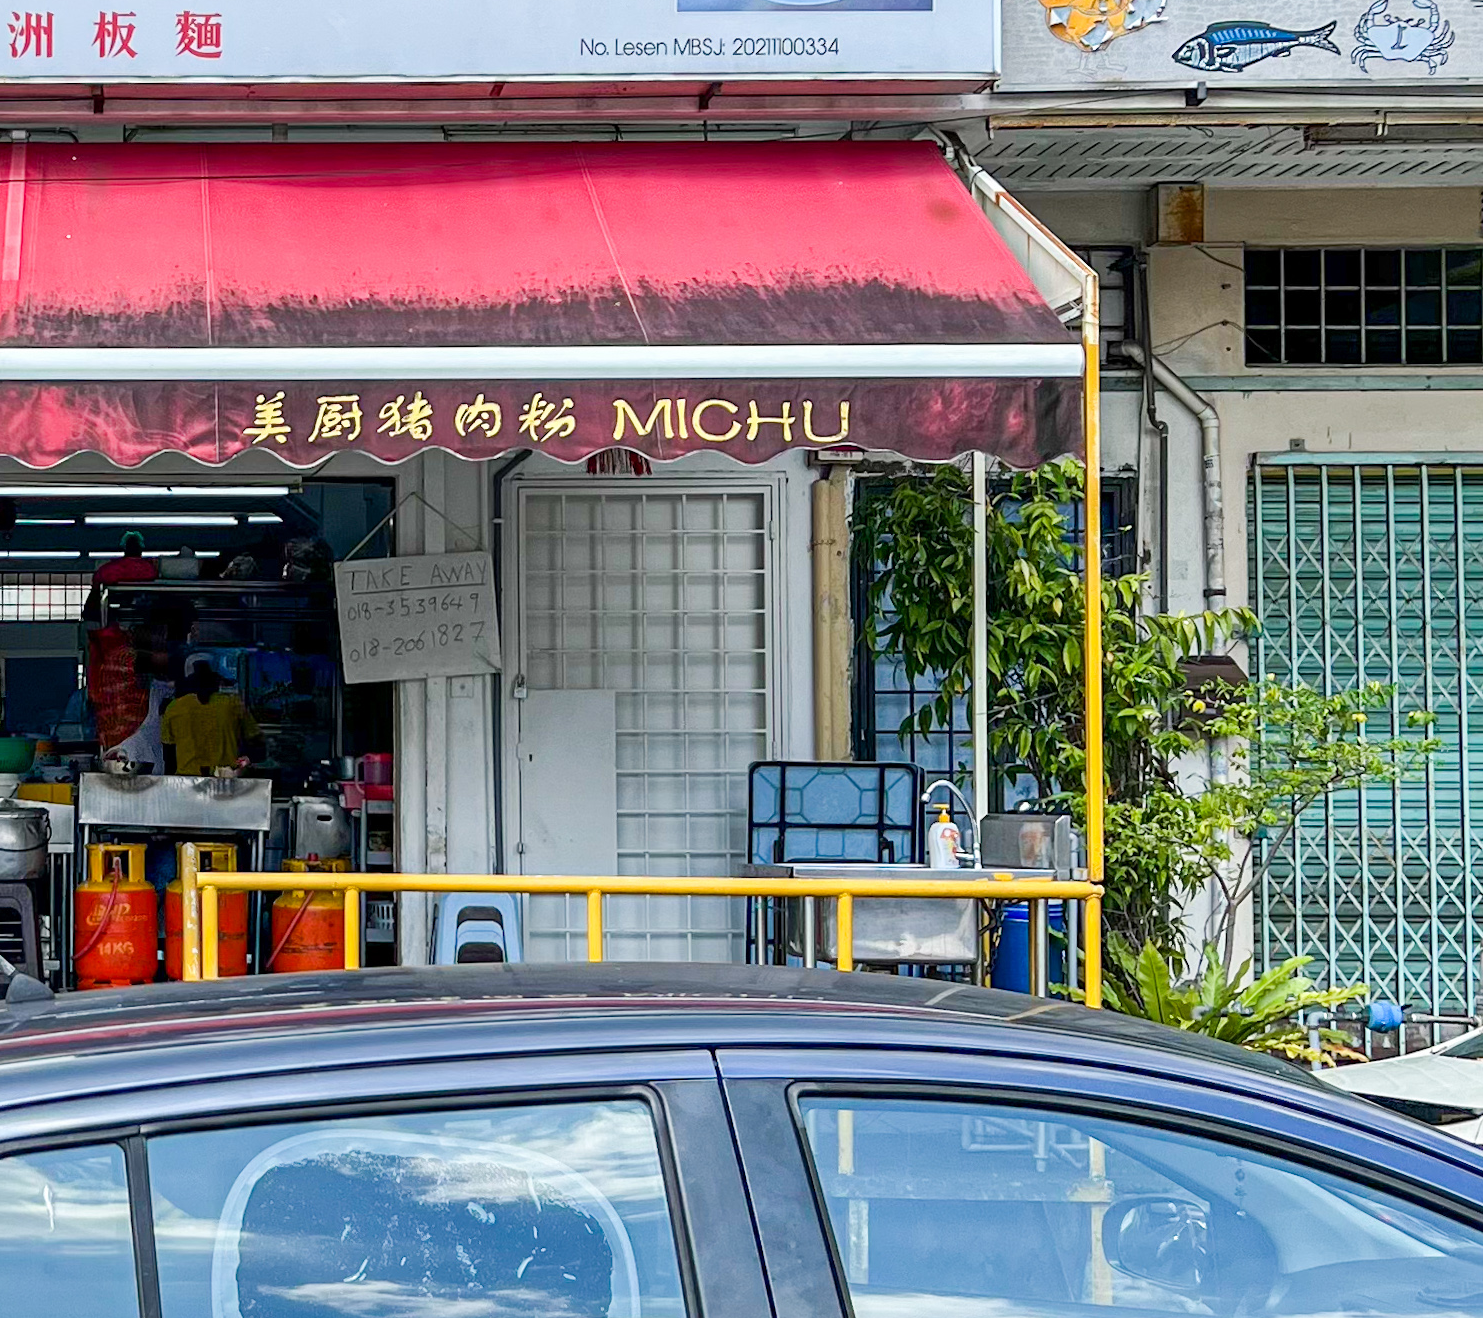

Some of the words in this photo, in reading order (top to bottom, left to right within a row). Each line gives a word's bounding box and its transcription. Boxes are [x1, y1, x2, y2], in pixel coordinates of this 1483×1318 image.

[580, 37, 610, 56] No.
[615, 37, 668, 57] Lesen
[673, 37, 726, 56] MBSJ:
[613, 398, 850, 443] MICHU
[343, 565, 413, 591] TAKE
[430, 559, 487, 586] AWAY
